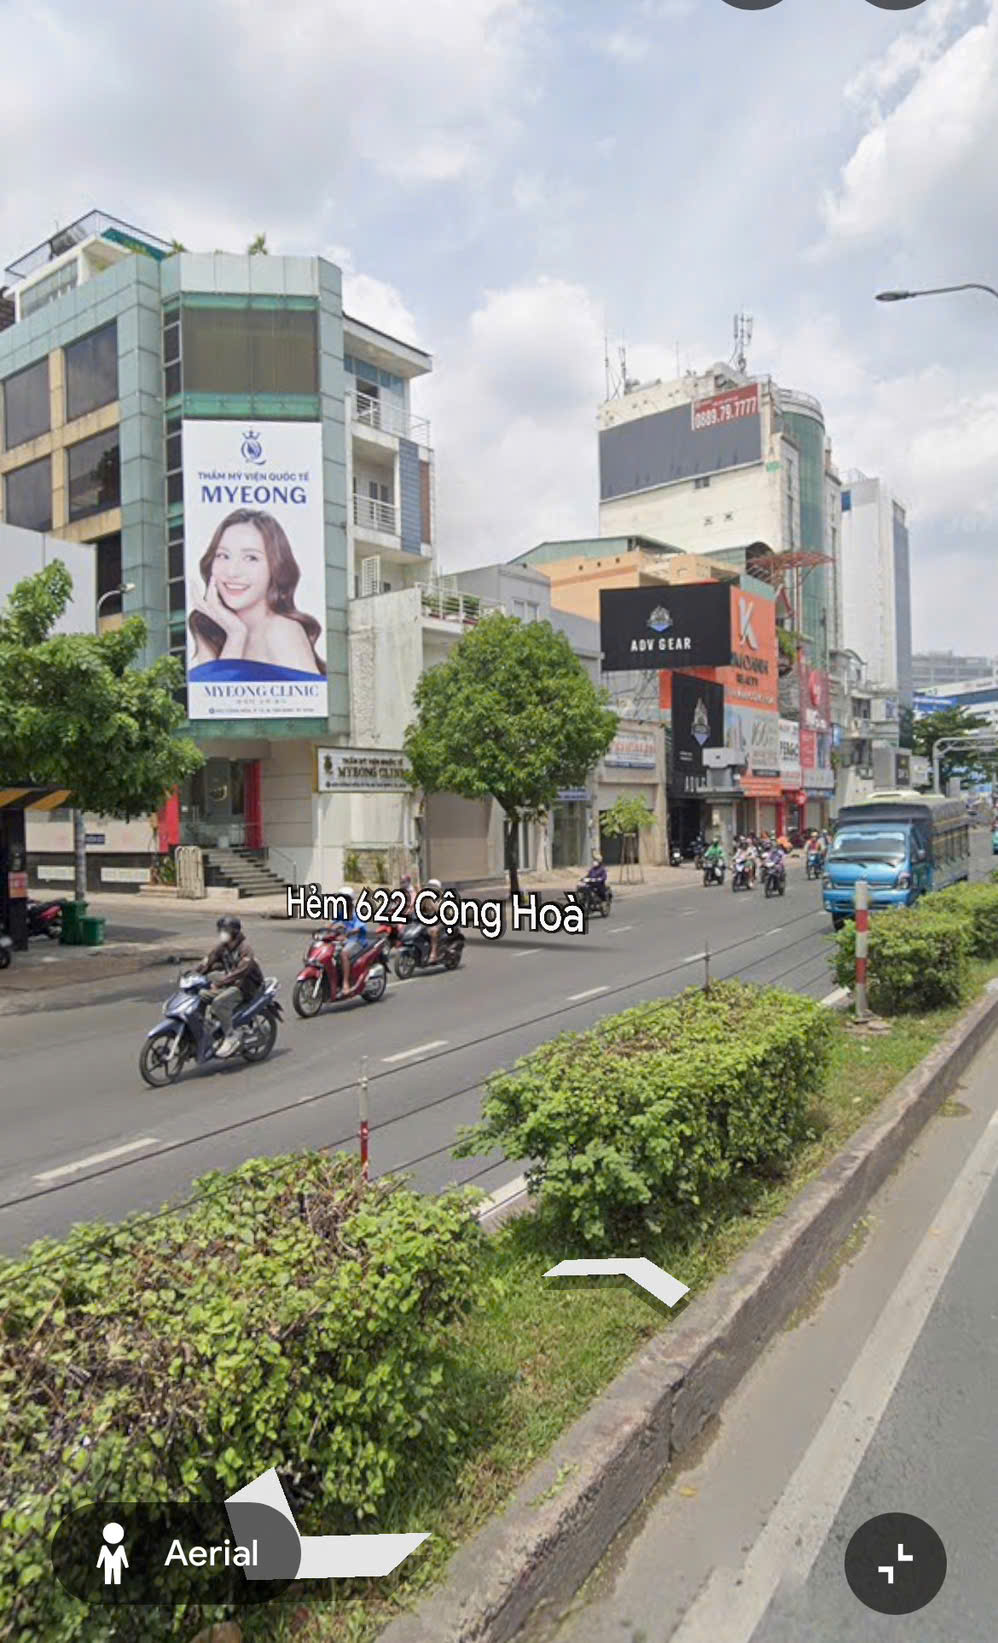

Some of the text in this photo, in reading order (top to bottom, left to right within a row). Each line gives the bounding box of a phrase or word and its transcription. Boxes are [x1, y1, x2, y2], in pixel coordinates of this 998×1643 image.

[244, 471, 267, 482] VIỆN
[268, 471, 297, 482] QUỐC
[201, 485, 307, 505] MYEONG
[630, 636, 692, 652] ADV GEAR
[204, 685, 319, 697] MYEONG CLINIC
